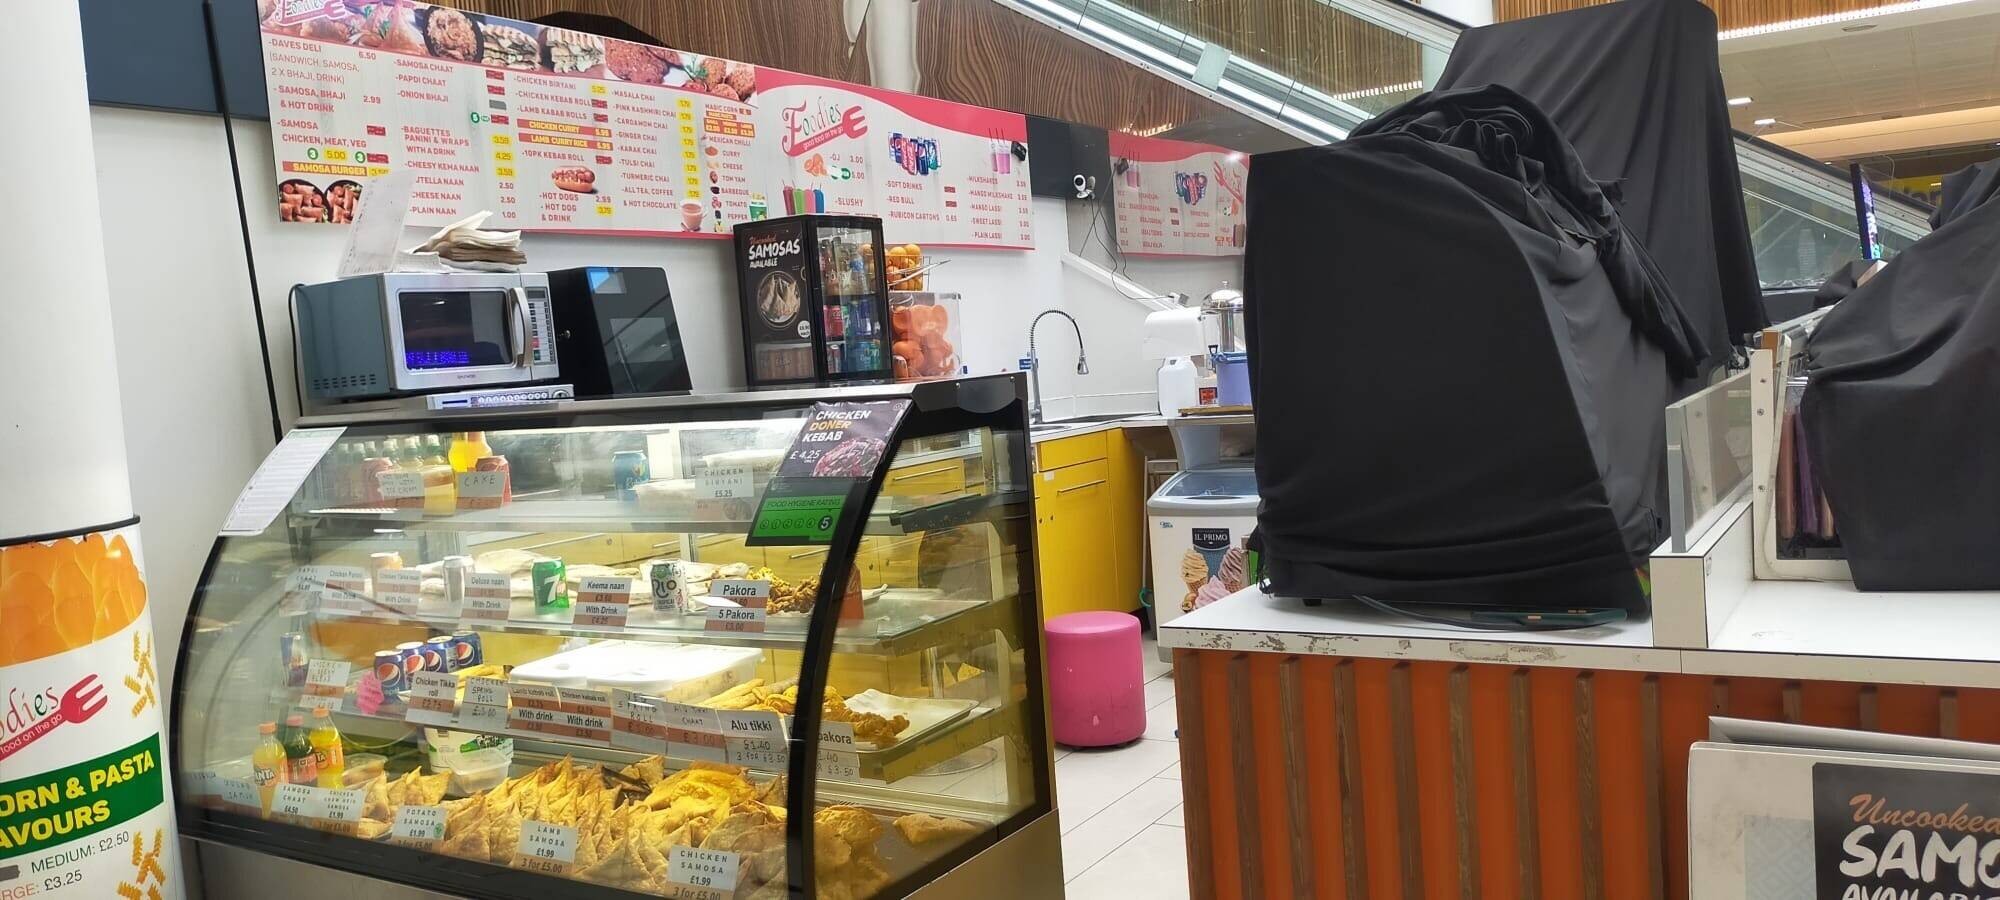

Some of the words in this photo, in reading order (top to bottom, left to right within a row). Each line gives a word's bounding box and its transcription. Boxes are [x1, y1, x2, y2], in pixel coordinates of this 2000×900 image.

[303, 41, 321, 52] DELI
[271, 67, 277, 76] 2
[320, 89, 345, 101] BHAJI
[280, 100, 287, 108] &
[288, 101, 306, 110] HOT
[308, 102, 335, 112] DRINK
[782, 96, 842, 156] Foodies
[350, 139, 367, 148] VEG
[406, 145, 426, 154] WITH
[434, 147, 456, 156] DRINK
[293, 163, 331, 173] SAMOSA
[331, 165, 367, 176] BURGER
[459, 164, 480, 173] NAAN
[545, 203, 560, 211] HOT
[561, 204, 577, 212] DOG
[548, 214, 572, 222] DRINK
[748, 238, 801, 261] SAMOSAS
[815, 409, 872, 421] CHICKEN
[809, 420, 852, 432] DONER
[802, 430, 844, 443] KEBAB
[799, 449, 822, 460] 4.25
[704, 468, 744, 477] CHICKEN
[464, 473, 497, 487] CAKE
[1194, 533, 1203, 541] IL
[1203, 533, 1228, 541] PRIMO
[587, 580, 608, 590] Keema
[609, 582, 625, 590] naan
[723, 584, 756, 597] Pakora
[472, 599, 485, 608] With
[485, 600, 502, 609] Drink
[585, 605, 599, 614] With
[600, 606, 618, 615] Drink
[718, 609, 724, 619] 5
[725, 609, 755, 620] Pakora
[415, 676, 439, 687] Chicken
[440, 679, 456, 688] Tikka
[428, 689, 439, 697] roll
[519, 708, 535, 718] With
[535, 711, 553, 721] drink
[567, 714, 583, 726] With
[584, 717, 604, 728] drink
[730, 719, 748, 732] Alu
[749, 719, 773, 732] tikki
[22, 730, 36, 742] on
[34, 721, 50, 734] the
[50, 713, 63, 727] go
[66, 776, 86, 800] &
[89, 749, 156, 793] PASTA
[282, 785, 312, 795] SAMOSA
[284, 805, 299, 815] £4.50
[406, 808, 437, 817] POTATO
[403, 818, 435, 827] SAMOSA
[409, 829, 426, 838] £1.99
[537, 825, 561, 836] LAMB
[529, 835, 566, 848] SAMOSA
[31, 843, 96, 874] MEDIUM:
[99, 830, 130, 852] £2.50
[535, 849, 555, 859] £1.99
[680, 850, 728, 863] CHICKEN
[521, 858, 528, 868] 3
[529, 858, 541, 870] for
[541, 861, 563, 874] £5.00
[680, 861, 724, 875] SAMOSA
[44, 868, 83, 891] £3.25
[689, 875, 712, 887] £1.99
[672, 886, 680, 897] 3
[681, 887, 695, 898] for
[696, 890, 721, 900] £5.00
